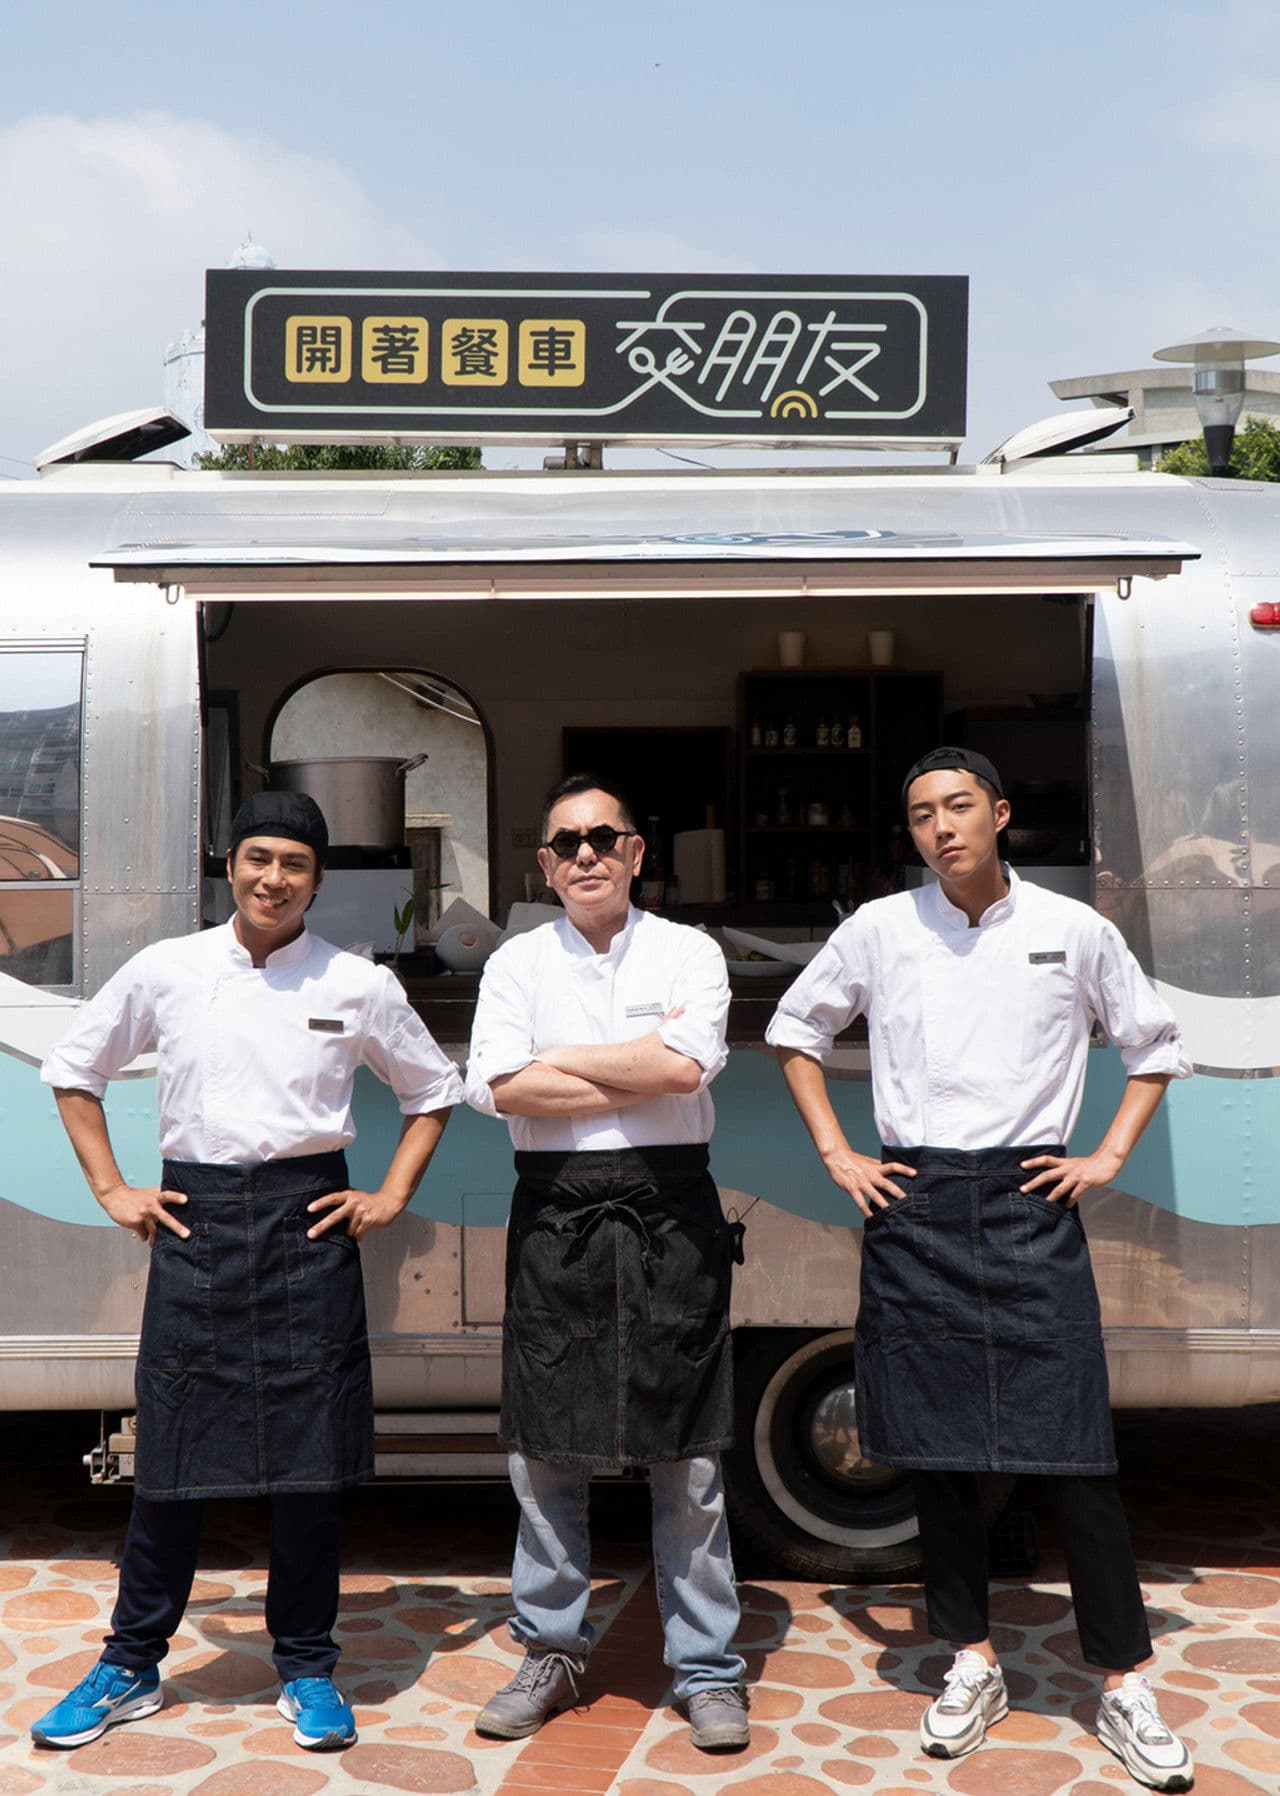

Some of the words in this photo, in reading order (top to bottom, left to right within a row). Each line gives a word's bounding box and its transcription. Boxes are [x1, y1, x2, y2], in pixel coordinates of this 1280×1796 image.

[296, 324, 577, 377] 開著餐車
[615, 292, 888, 408] 交朋友
